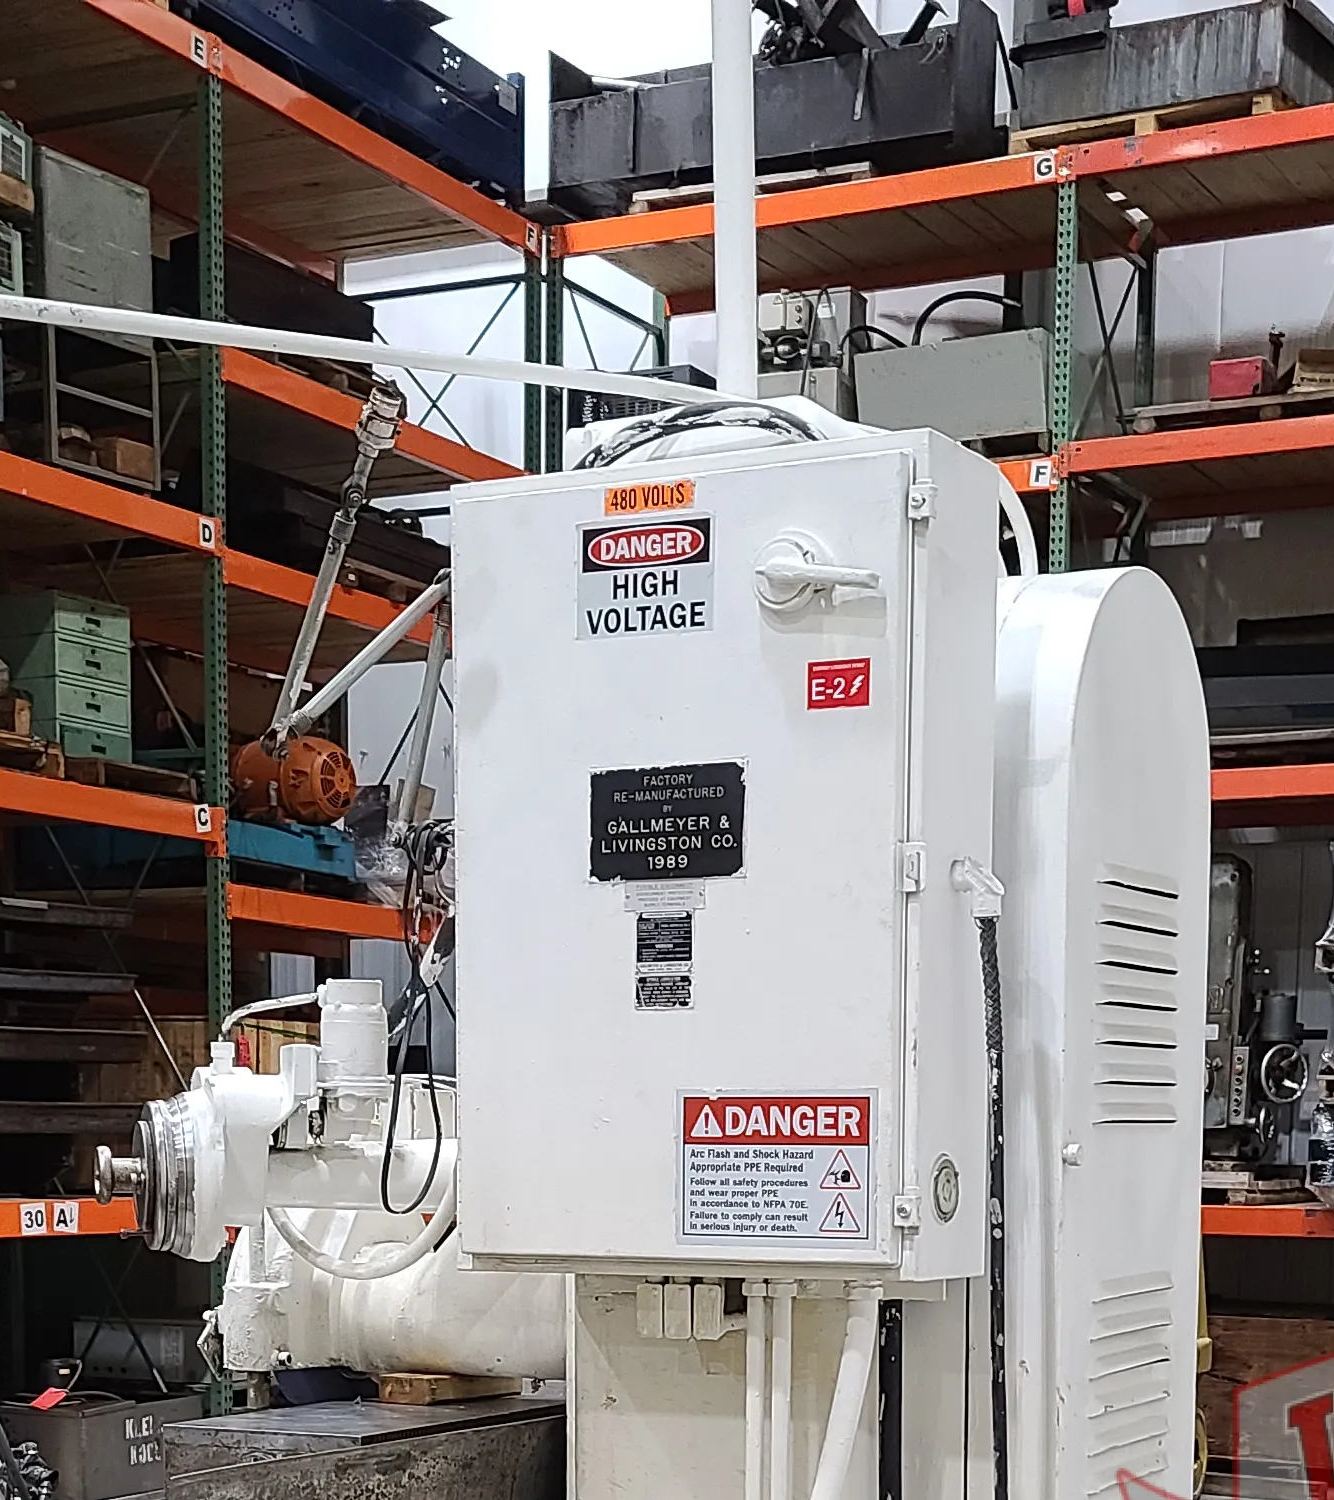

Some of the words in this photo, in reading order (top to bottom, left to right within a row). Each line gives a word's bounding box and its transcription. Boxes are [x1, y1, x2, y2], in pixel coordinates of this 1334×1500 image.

[194, 36, 204, 60] E
[1037, 157, 1052, 176] G
[528, 226, 535, 242] F
[1034, 465, 1048, 482] F
[611, 488, 637, 510] 480
[642, 483, 685, 507] VOLTS
[202, 522, 212, 543] D
[600, 531, 692, 561] DANGER
[613, 569, 678, 600] HIGH
[586, 601, 706, 635] VOLTAGE
[811, 677, 845, 701] E-2
[643, 774, 693, 787] FACTORY
[613, 786, 725, 803] RE-MANUFACTURED
[198, 807, 208, 827] C
[662, 804, 673, 813] BY
[607, 816, 710, 835] GALLMEYER
[719, 815, 730, 829] &
[601, 835, 702, 854] LIVINGSTON
[711, 834, 738, 848] CO.
[647, 854, 688, 870] 1989
[724, 1105, 861, 1137] DANGER
[689, 1149, 705, 1159] Arc
[707, 1149, 731, 1159] Flash
[733, 1149, 750, 1159] and
[752, 1149, 780, 1159] Shock
[782, 1149, 814, 1160] Hazard
[689, 1162, 741, 1174] Appropriate
[743, 1162, 762, 1172] PPE
[764, 1162, 804, 1174] Required
[689, 1177, 717, 1186] Follow
[719, 1178, 730, 1186] all
[733, 1178, 758, 1188] safety
[761, 1179, 809, 1189] procedures
[689, 1189, 705, 1197] and
[708, 1190, 728, 1198] wear
[731, 1190, 759, 1199] proper
[761, 1190, 779, 1198] PPE
[689, 1199, 698, 1207] in
[700, 1200, 748, 1208] accordance
[763, 1200, 786, 1209] NFPA
[24, 1210, 44, 1228] 30
[56, 1208, 69, 1228] A
[689, 1211, 718, 1220] Failure
[720, 1212, 730, 1220] to
[732, 1212, 763, 1222] comply
[784, 1213, 809, 1222] result
[689, 1222, 698, 1230] in
[700, 1223, 730, 1231] serious
[733, 1223, 757, 1233] injury
[771, 1224, 798, 1232] death.
